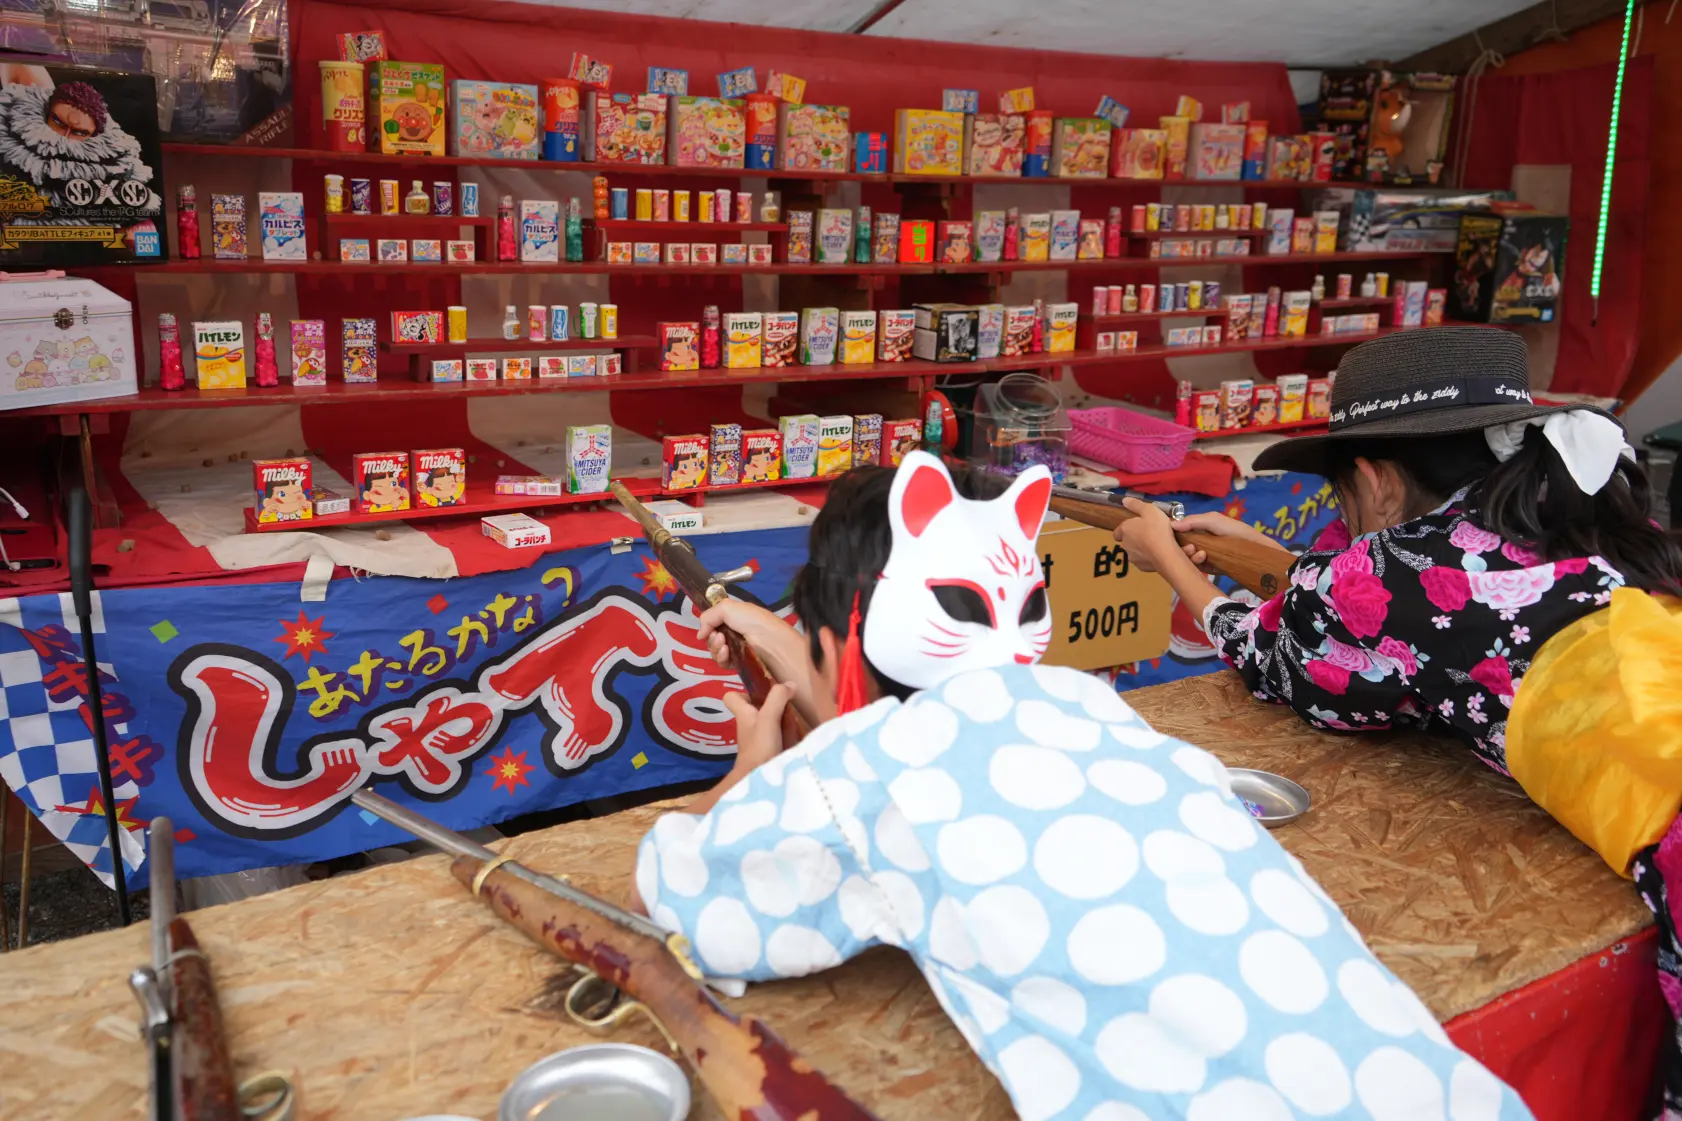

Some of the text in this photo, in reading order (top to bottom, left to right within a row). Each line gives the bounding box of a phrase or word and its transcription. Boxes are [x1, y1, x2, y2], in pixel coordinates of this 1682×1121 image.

[103, 206, 117, 216] the
[265, 219, 302, 229] カルピス
[525, 225, 556, 233] カルピス
[731, 321, 760, 331] ハイレモン
[768, 322, 797, 330] コーラパンチ
[199, 332, 241, 343] ハイレモン
[1380, 399, 1400, 410] way
[1401, 393, 1411, 405] to
[1413, 389, 1428, 401] the
[821, 427, 851, 436] ハイレモン
[674, 442, 704, 458] Milky
[747, 437, 778, 453] Milky
[788, 446, 813, 455] MITSUYA
[420, 455, 459, 471] Milky
[577, 458, 606, 468] MITSUYA
[791, 454, 809, 462] CIDER
[362, 459, 403, 478] Milky
[581, 467, 602, 476] CIDER
[262, 467, 307, 486] Milky
[671, 520, 697, 529] ハイレモン
[515, 535, 546, 547] コーラパンチ
[1069, 601, 1139, 643] 500円
